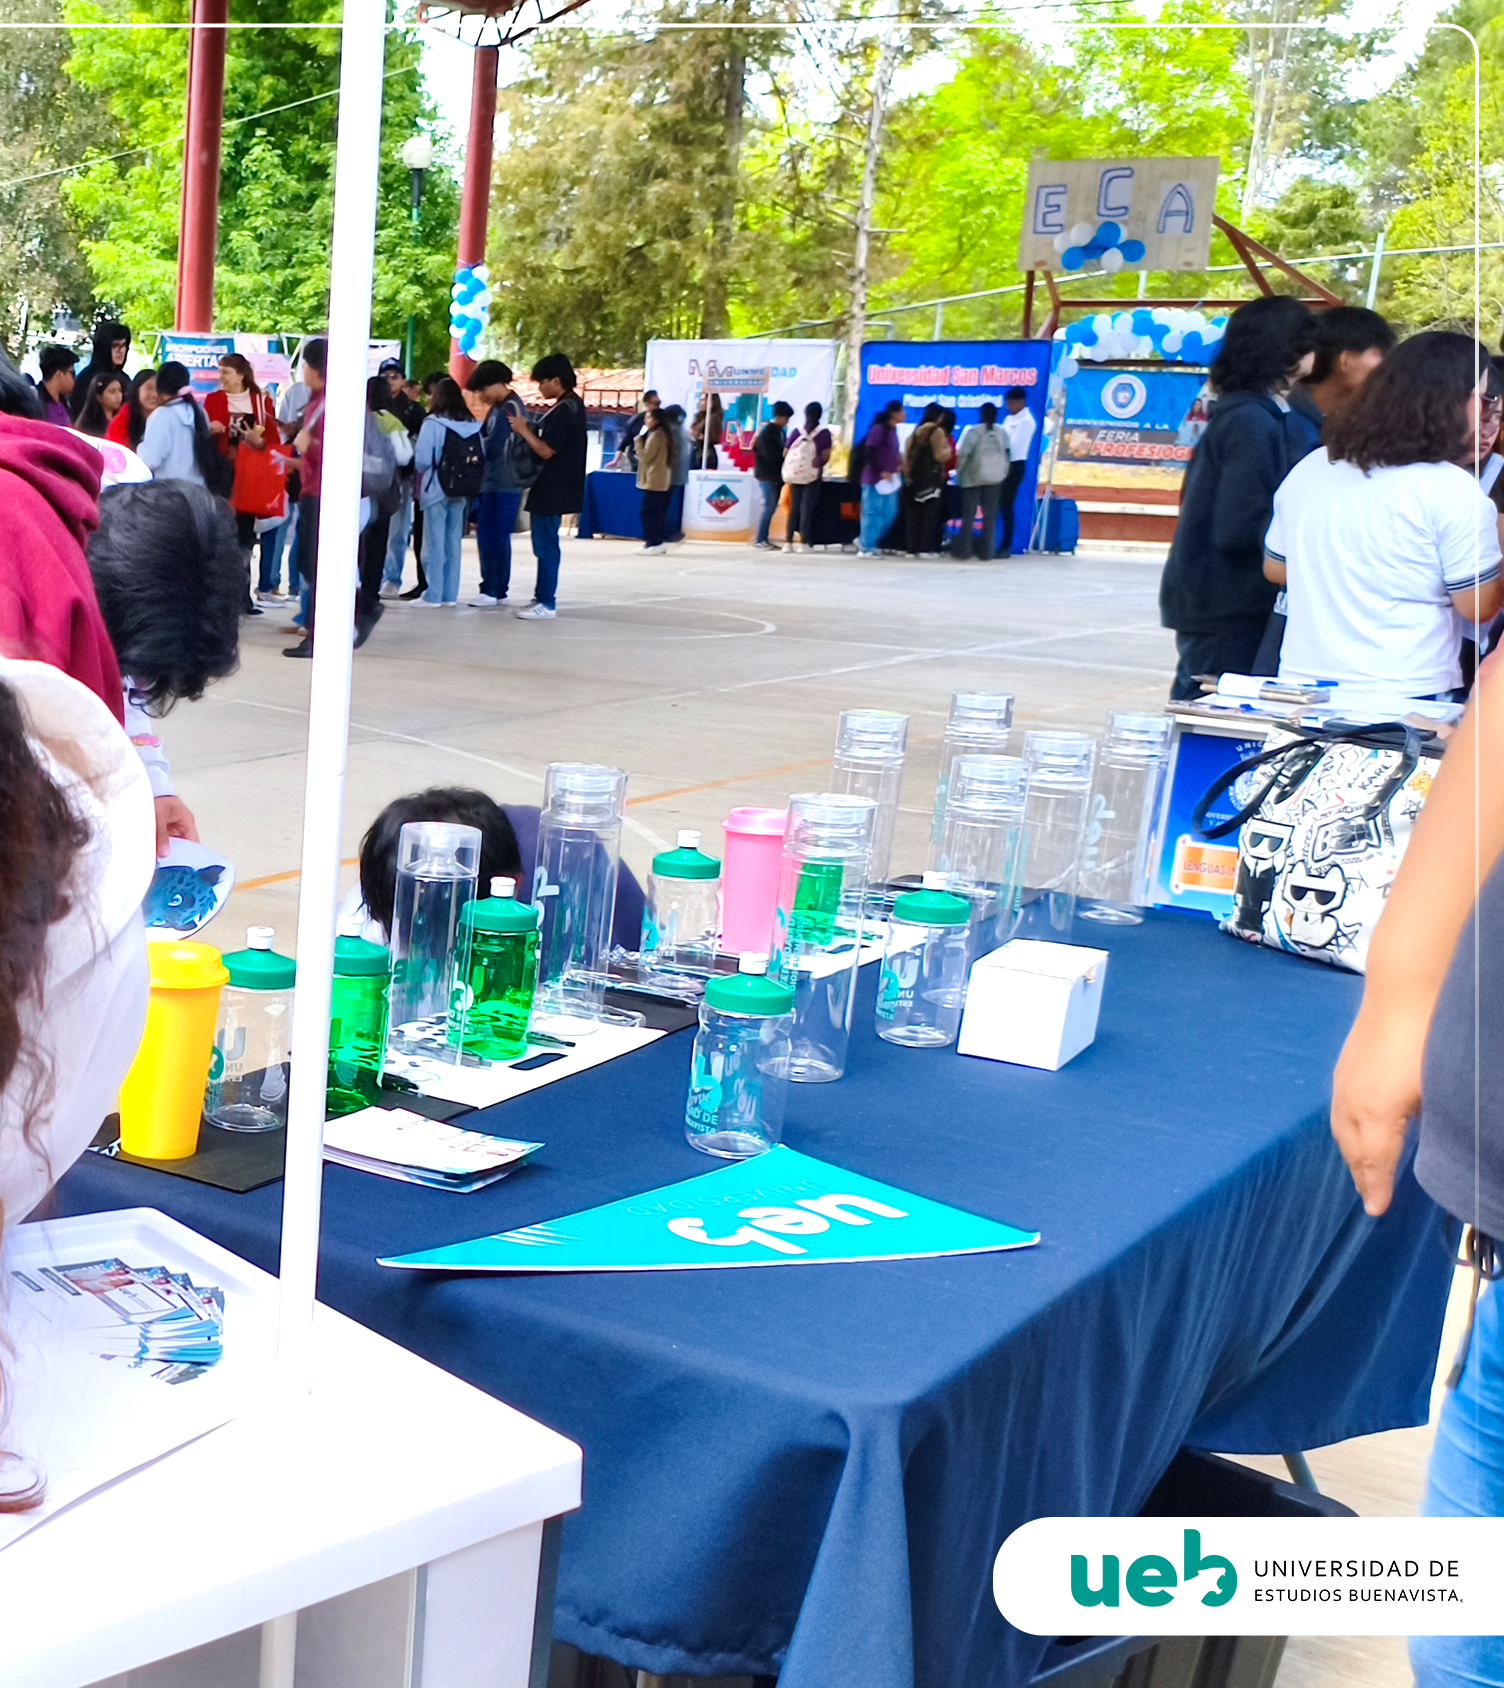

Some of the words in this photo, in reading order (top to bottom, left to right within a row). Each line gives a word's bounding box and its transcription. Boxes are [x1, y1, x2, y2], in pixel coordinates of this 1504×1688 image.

[867, 364, 950, 386] Universidad
[951, 366, 979, 386] San
[980, 365, 1037, 386] Marcos
[1096, 430, 1140, 442] FERIA
[1183, 861, 1226, 876] LENGUAS
